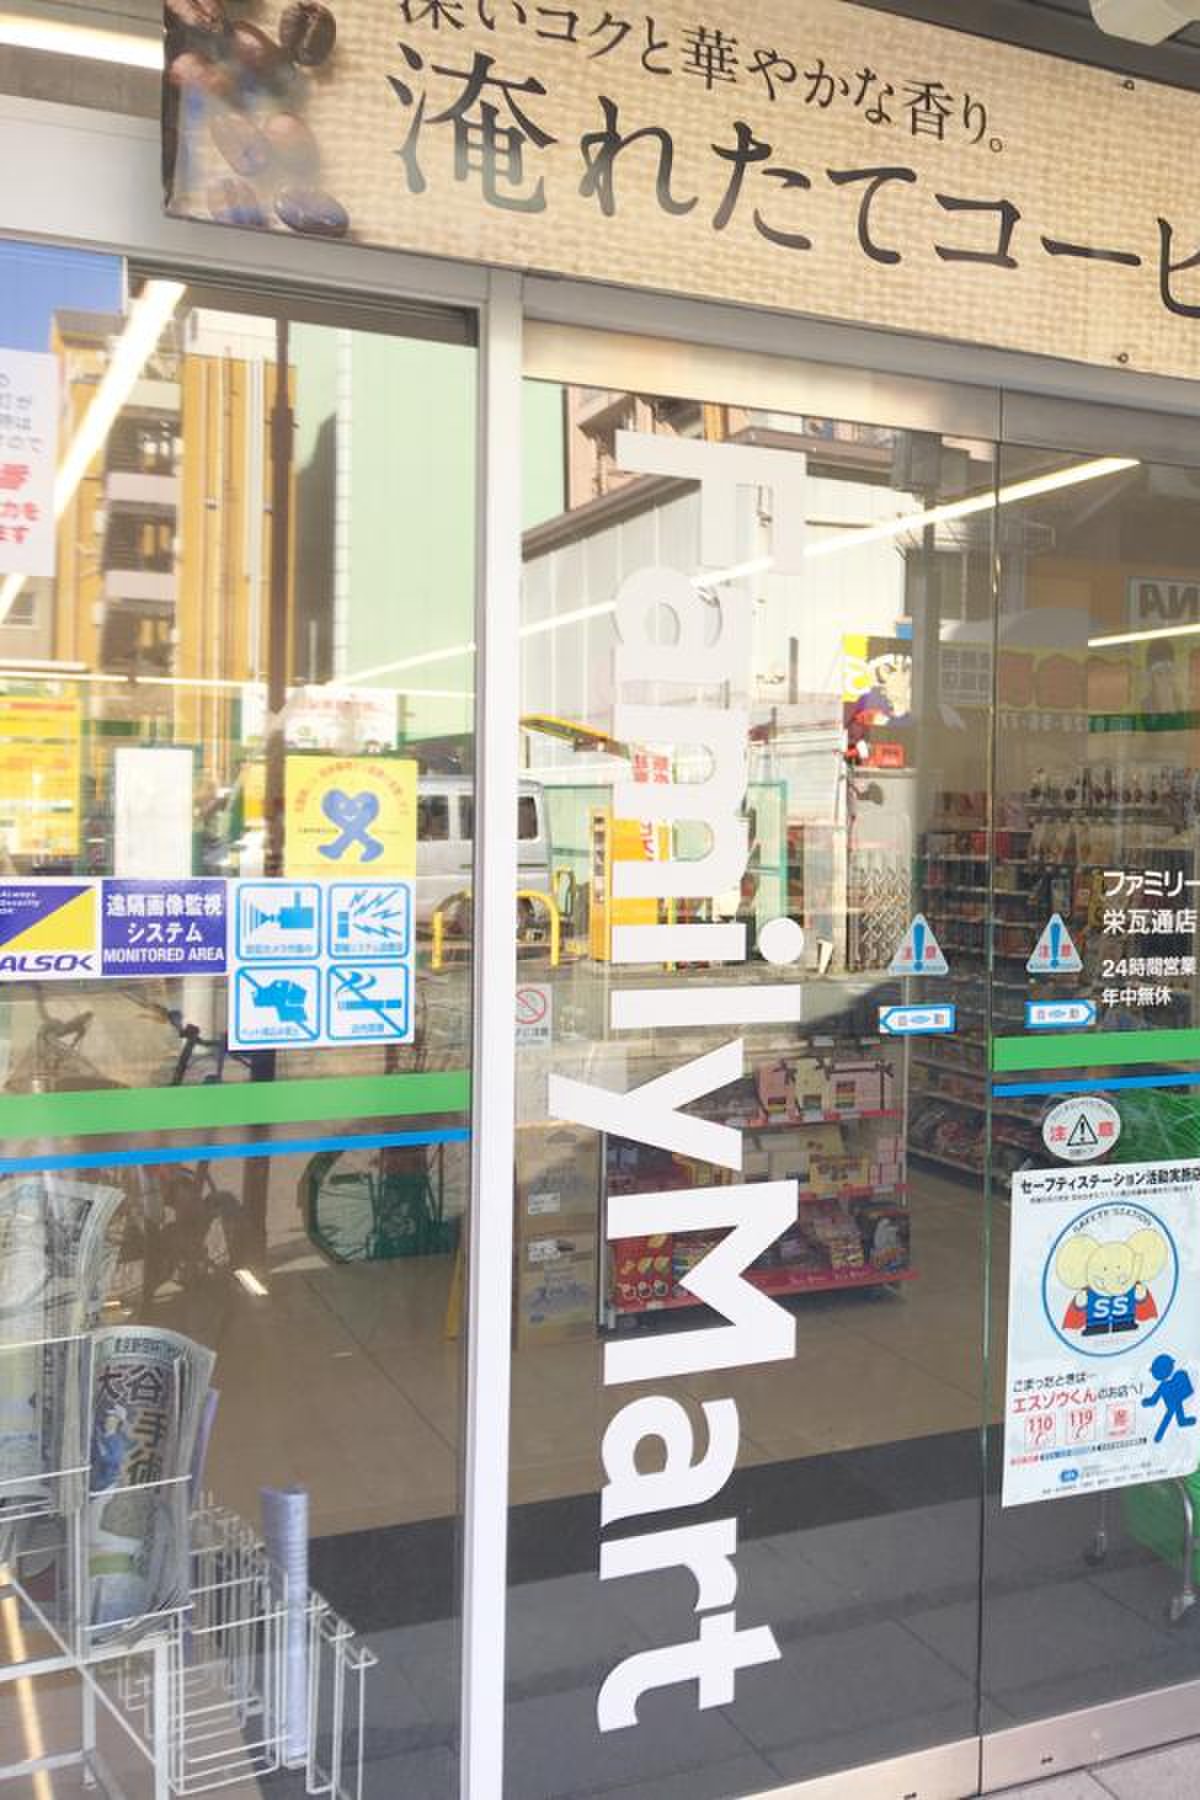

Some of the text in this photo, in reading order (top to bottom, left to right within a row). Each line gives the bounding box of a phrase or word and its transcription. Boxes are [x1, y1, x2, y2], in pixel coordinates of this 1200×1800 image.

[106, 893, 224, 918] 遠隔画像監視
[127, 922, 204, 944] システム
[1103, 909, 1198, 935] 栄瓦通店
[0, 953, 95, 973] ALSOK
[104, 947, 226, 964] MONITORED AREA
[1102, 956, 1197, 978] 24時間営業
[1101, 986, 1172, 1008] 年中無休
[547, 430, 806, 1733] FamilyMart
[1093, 1296, 1129, 1319] SS
[1029, 1416, 1053, 1433] 110
[1071, 1409, 1093, 1427] 119
